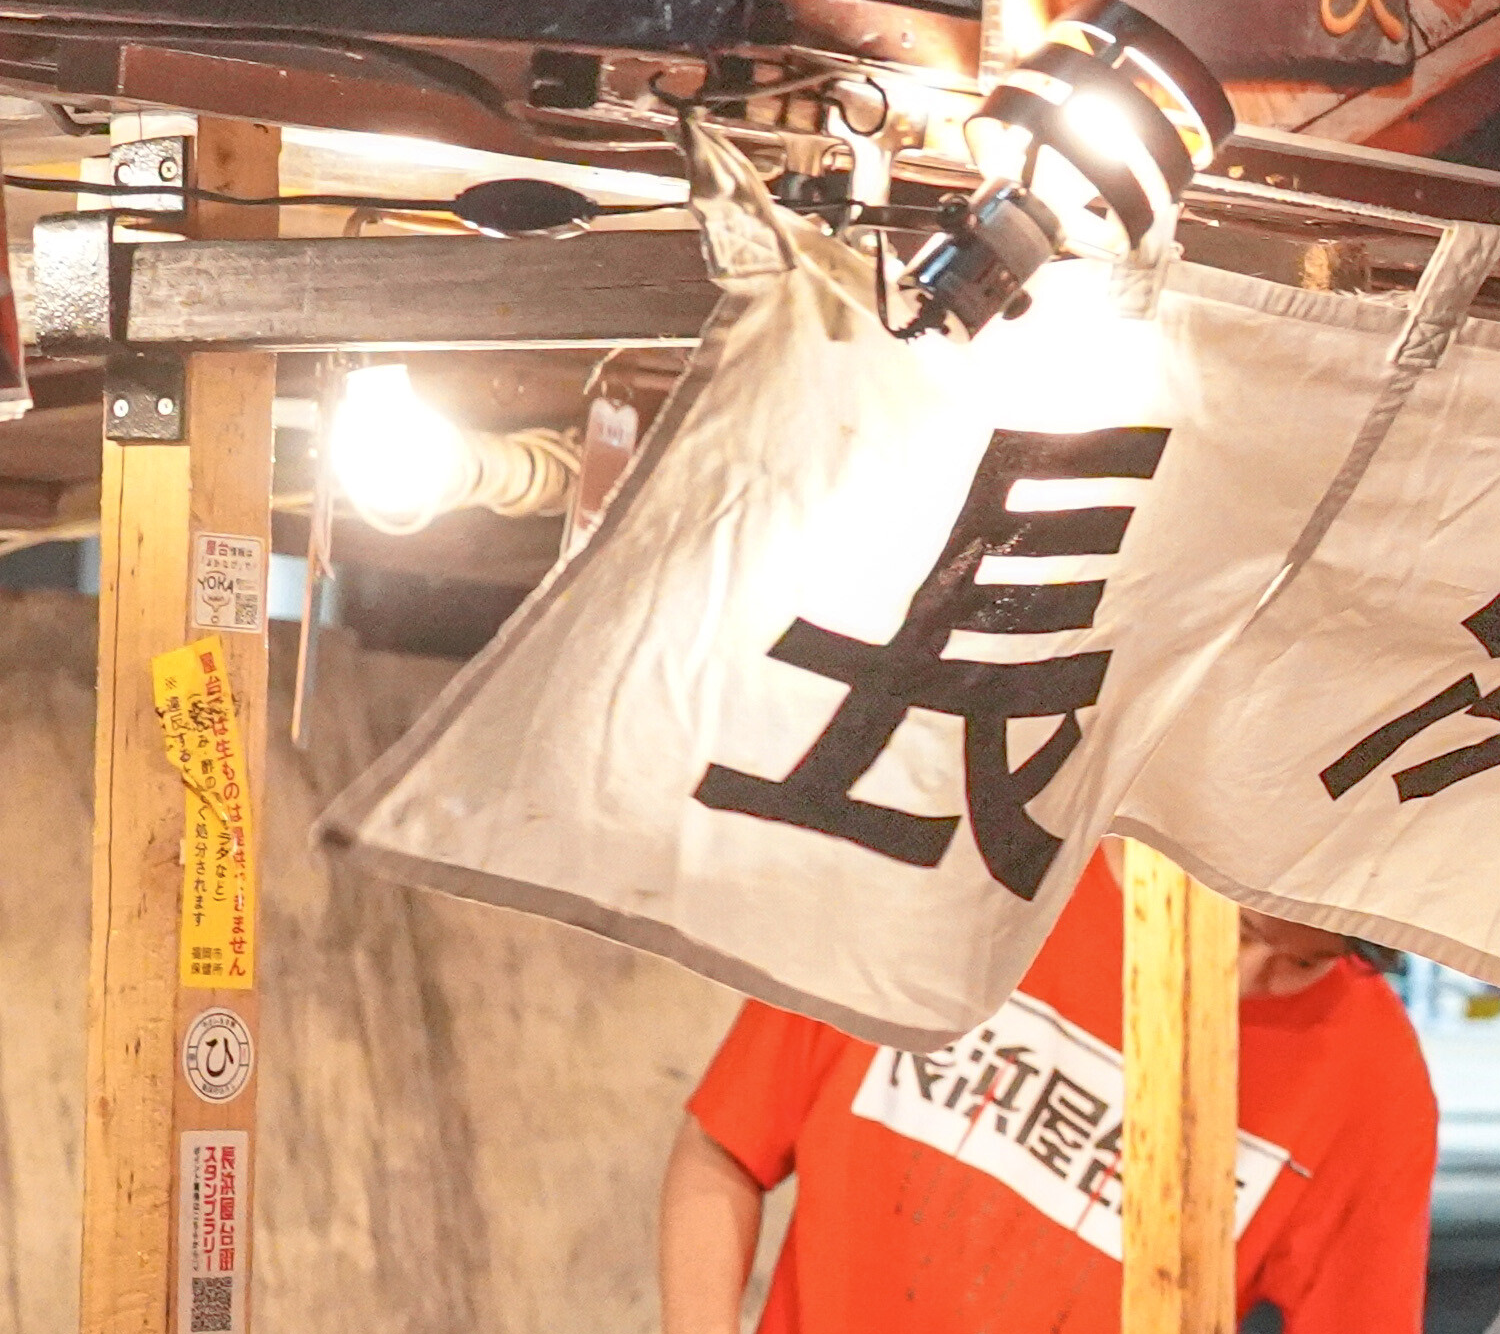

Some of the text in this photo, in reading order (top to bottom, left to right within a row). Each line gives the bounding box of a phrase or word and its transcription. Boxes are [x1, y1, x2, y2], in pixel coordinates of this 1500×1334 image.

[203, 1146, 218, 1272] スタンプラリー
